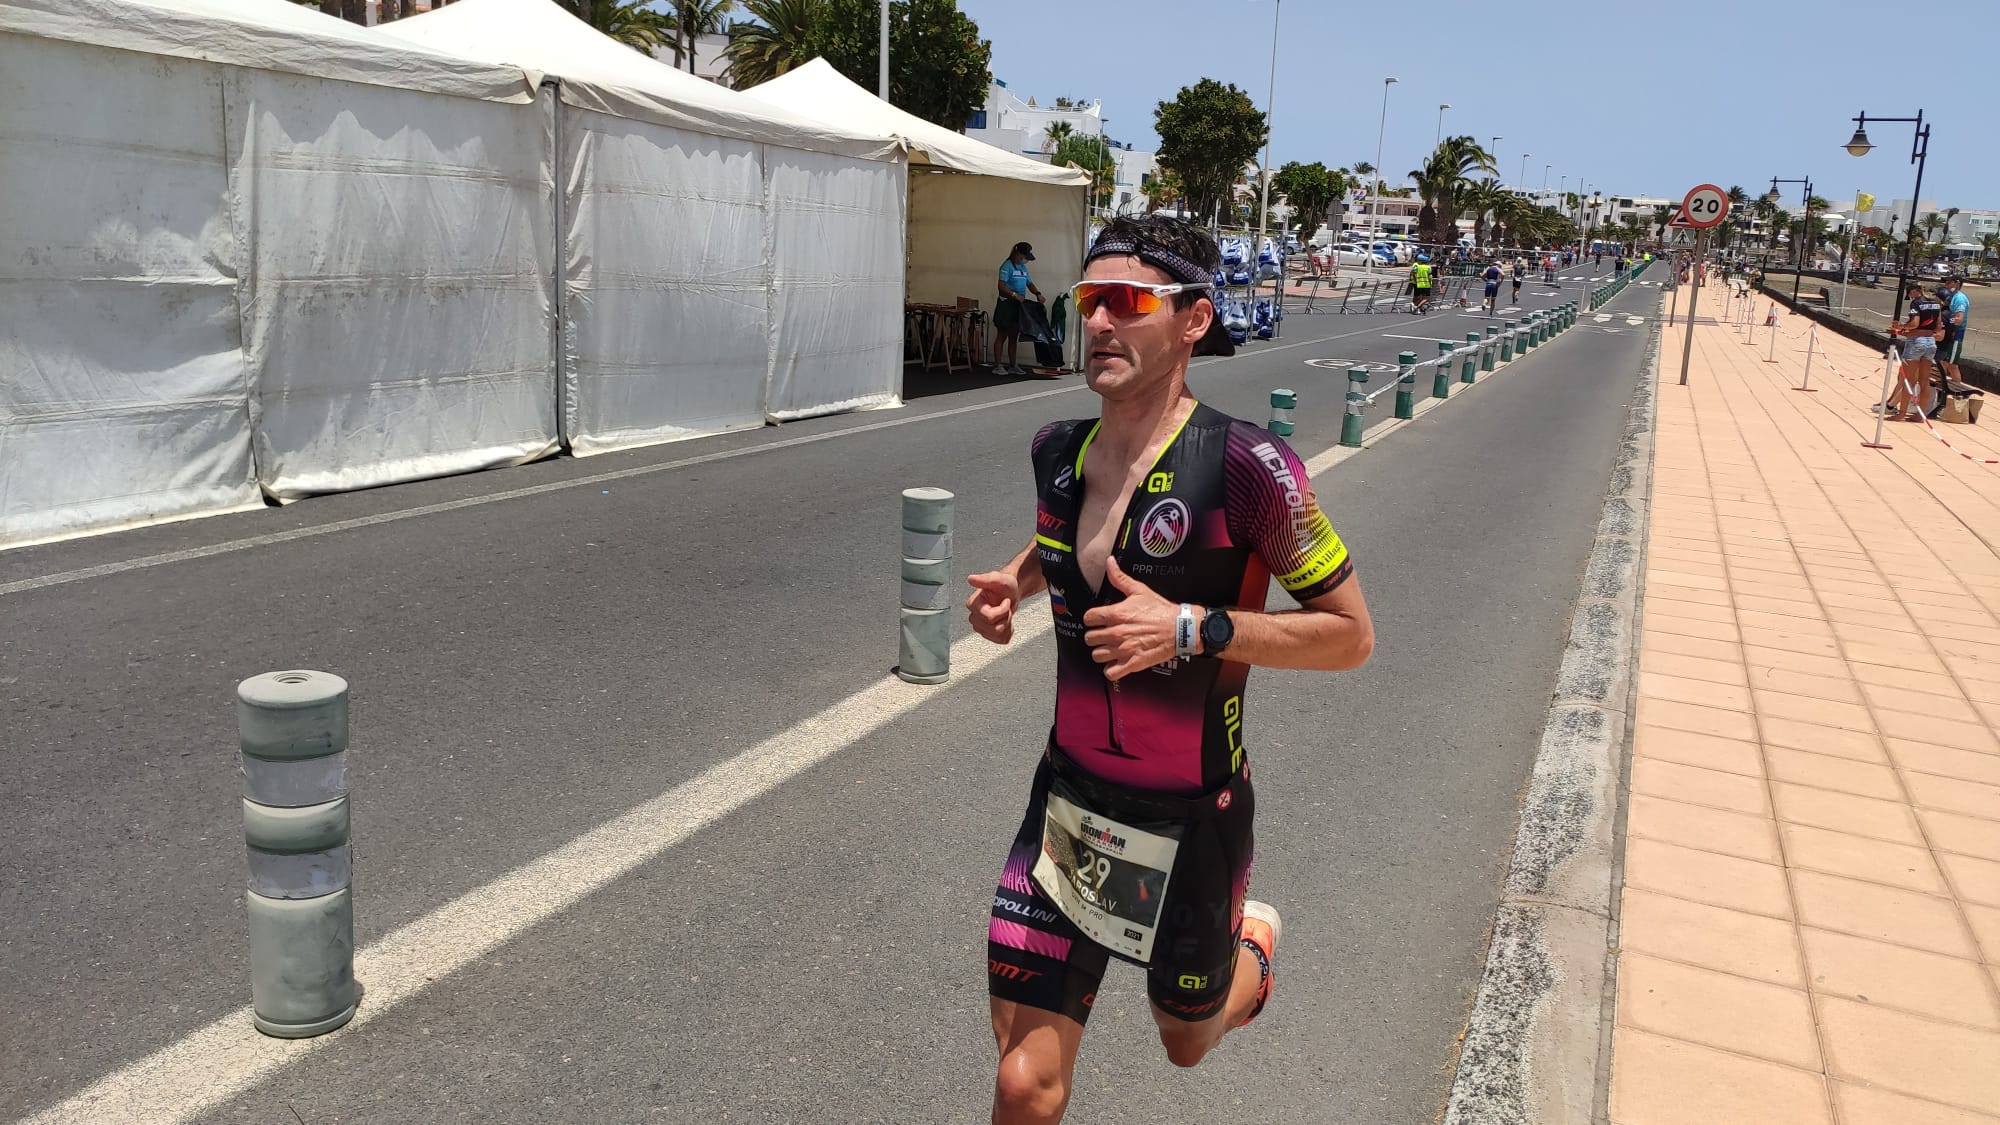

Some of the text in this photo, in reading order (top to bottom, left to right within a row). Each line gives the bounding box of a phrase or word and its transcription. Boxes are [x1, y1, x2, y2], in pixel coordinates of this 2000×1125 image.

[1692, 198, 1719, 213] 20
[1081, 822, 1126, 849] IRONMAN
[1077, 849, 1112, 889] 29
[1089, 908, 1103, 921] PRO
